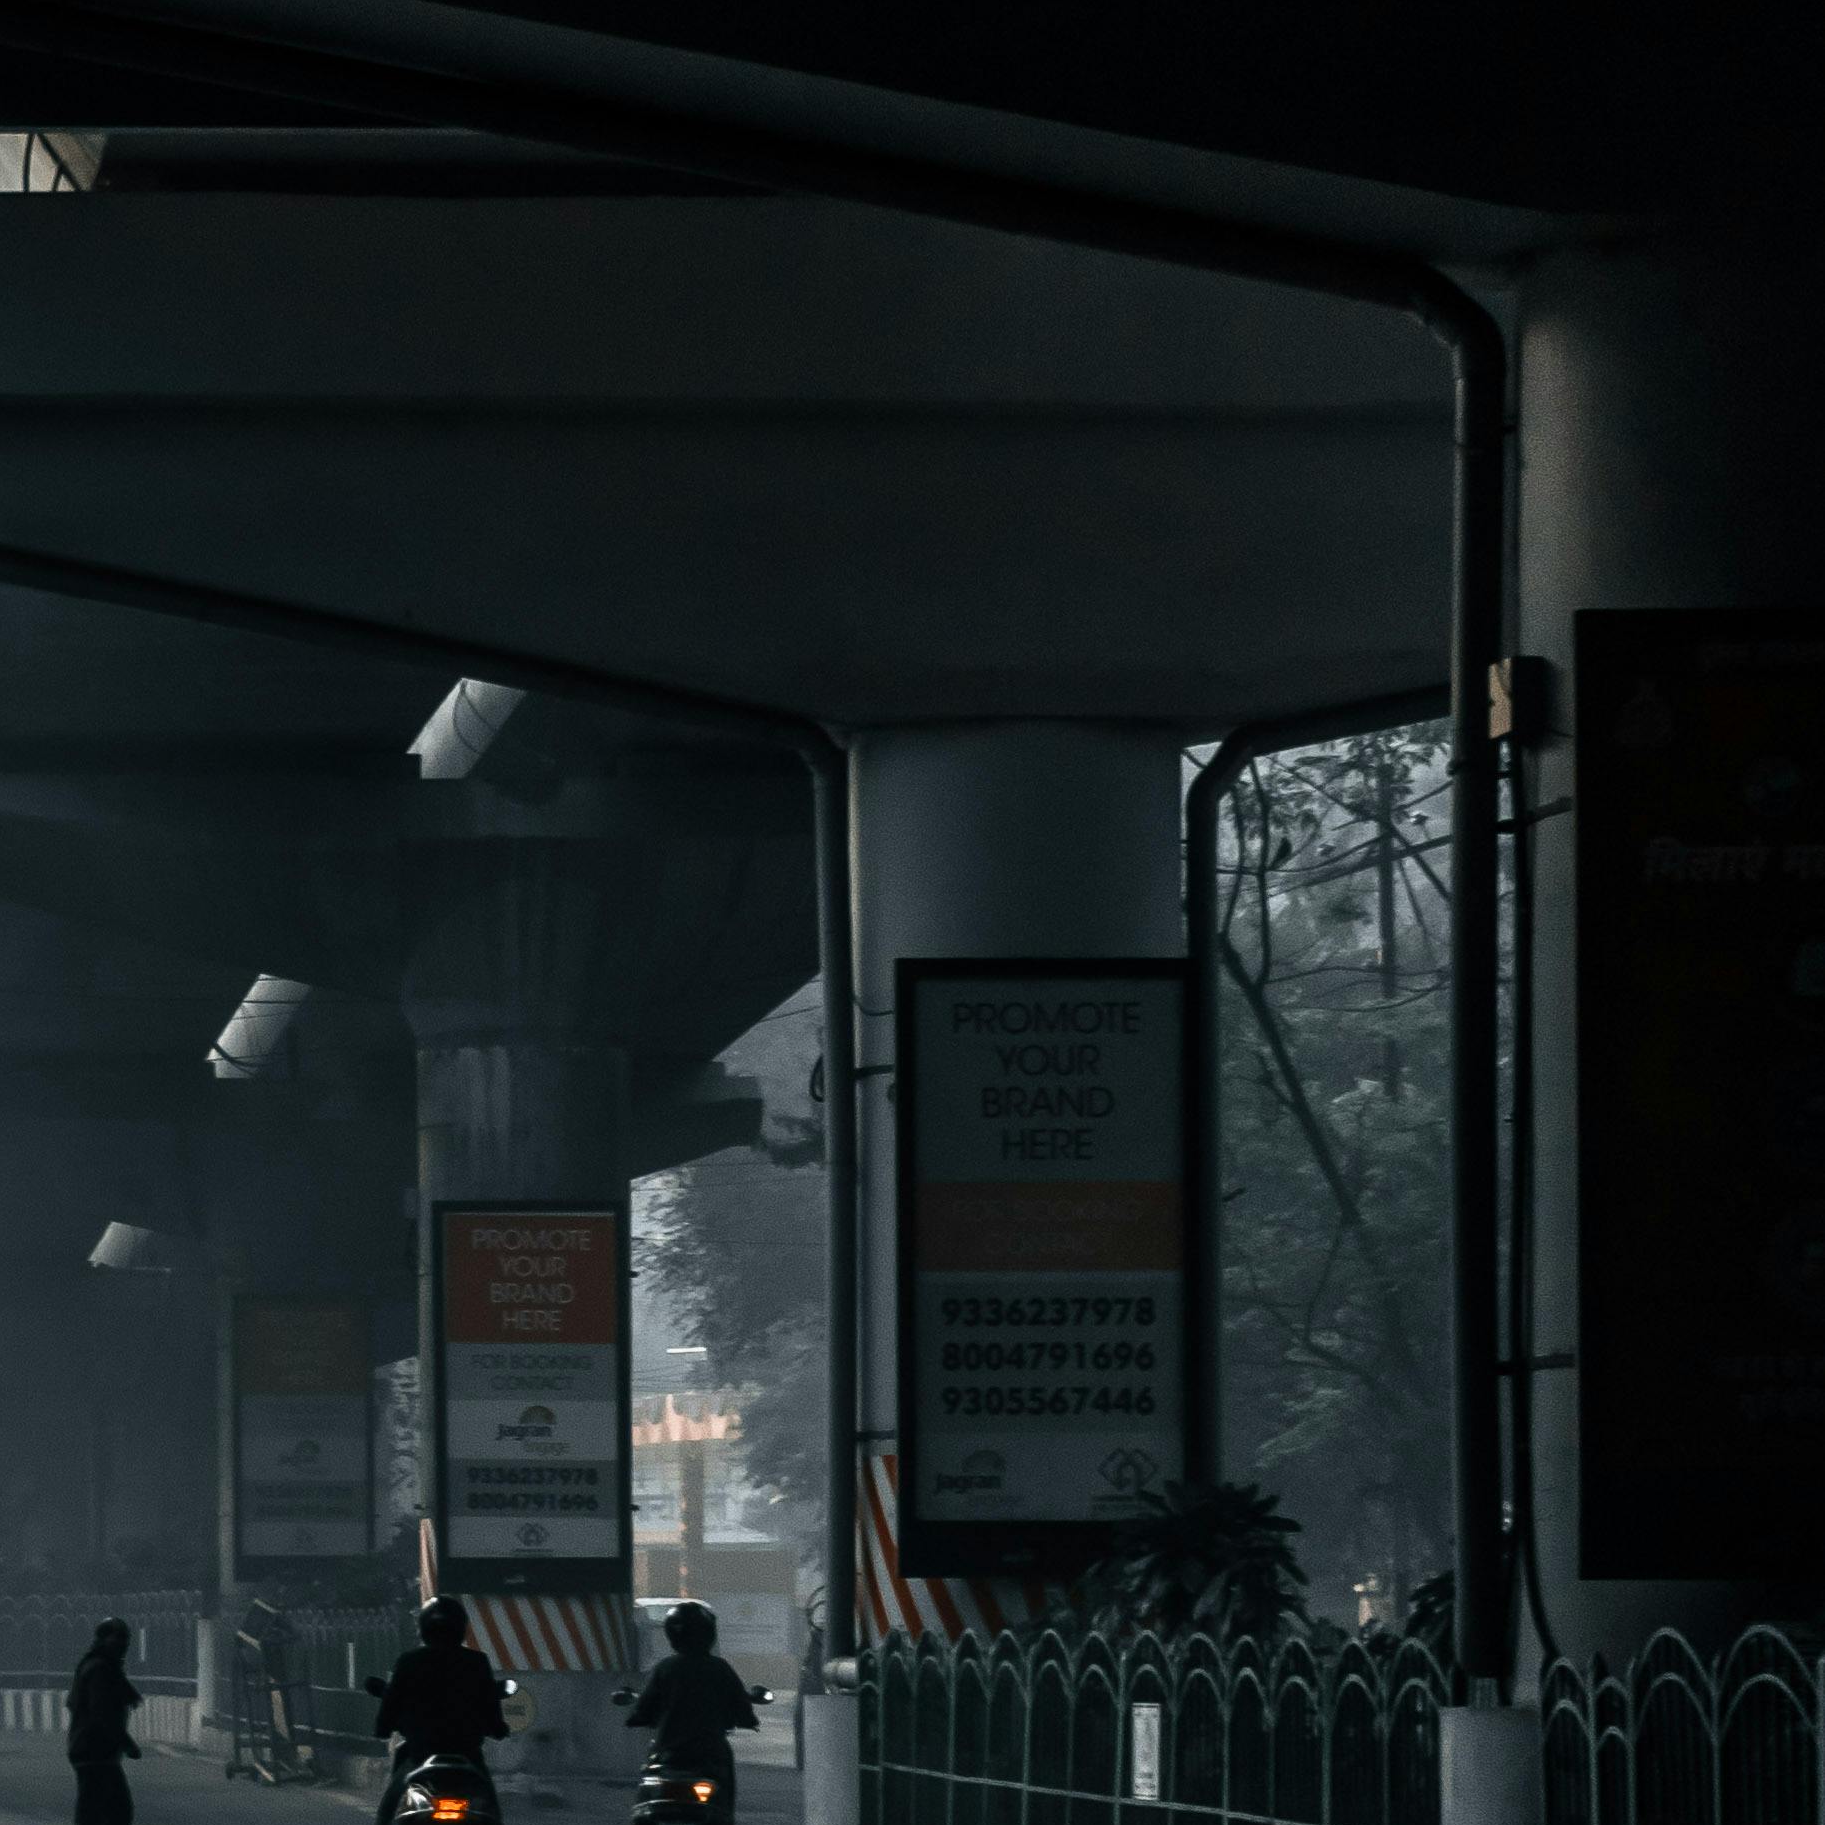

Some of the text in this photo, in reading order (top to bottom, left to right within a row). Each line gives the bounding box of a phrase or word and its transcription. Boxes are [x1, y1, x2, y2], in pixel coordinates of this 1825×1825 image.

[952, 1002, 1141, 1034] PROMOTE
[995, 1044, 1101, 1076] YOUR
[981, 1086, 1115, 1118] BRAND
[1001, 1128, 1095, 1161] HERE
[472, 1229, 591, 1250] PROMOTE
[498, 1256, 566, 1277] YOUR
[490, 1282, 575, 1304] BRAND
[502, 1309, 562, 1331] HERE
[942, 1296, 1156, 1327] 9336237978
[942, 1342, 1156, 1371] 8004791696
[942, 1387, 1156, 1415] 9305567446
[468, 1467, 598, 1485] 9336237978
[933, 1473, 1002, 1495] Jagran
[468, 1492, 599, 1511] 8004791696
